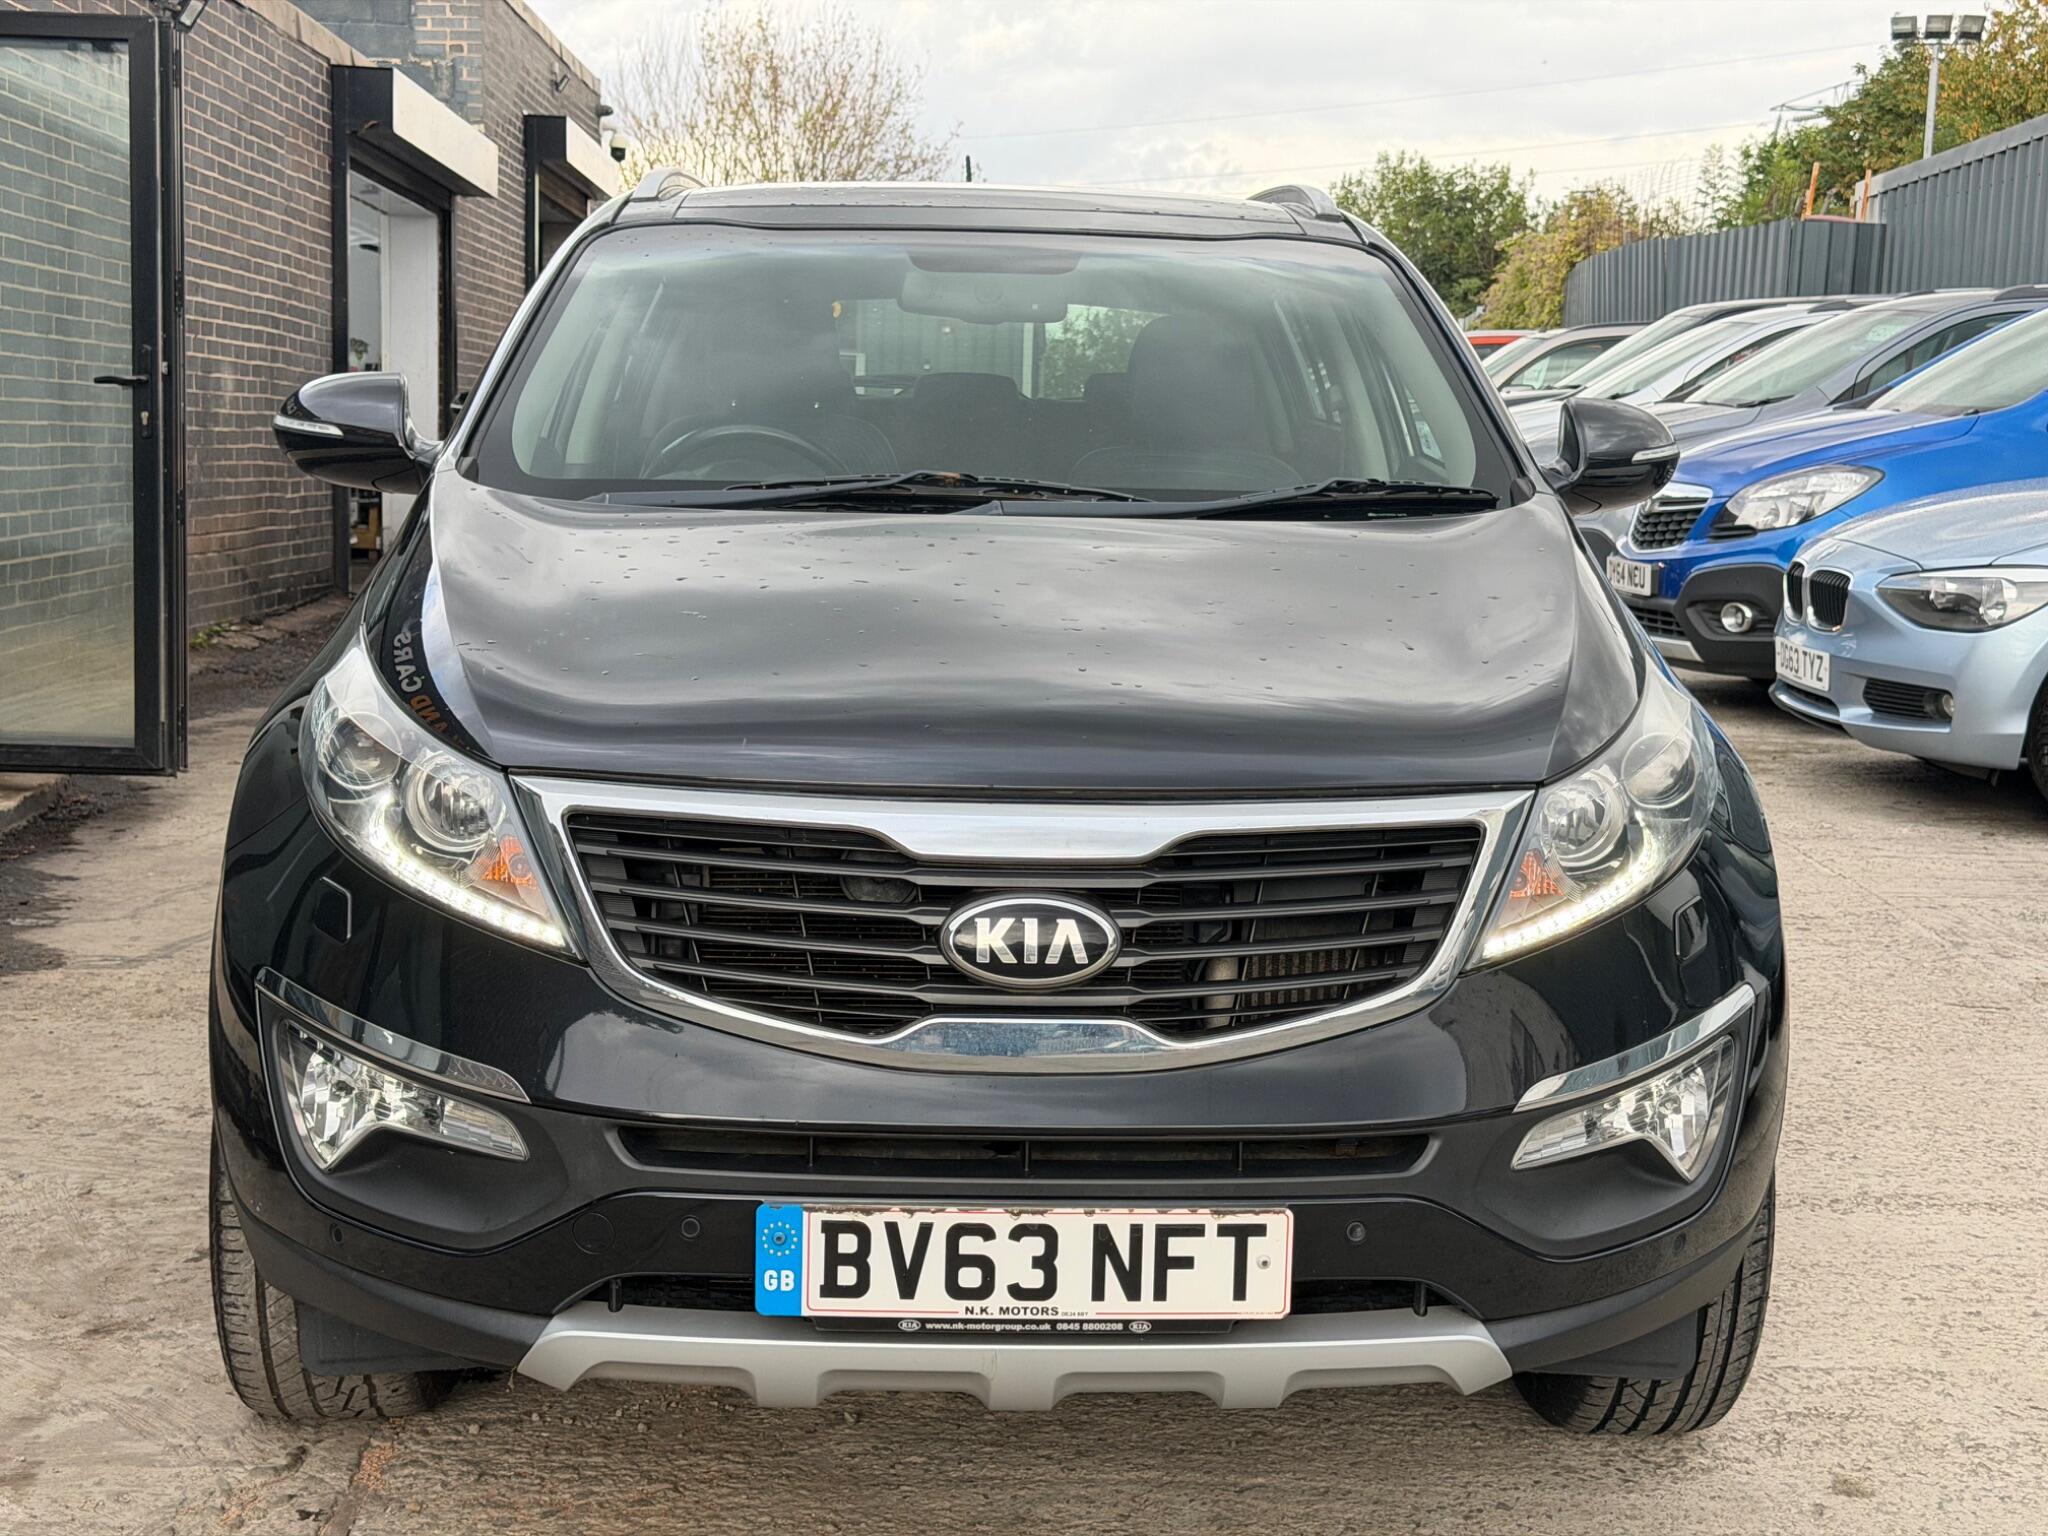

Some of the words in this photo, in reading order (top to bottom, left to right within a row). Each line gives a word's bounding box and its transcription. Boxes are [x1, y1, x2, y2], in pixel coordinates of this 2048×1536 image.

[1627, 561, 1646, 589] NEU
[1801, 650, 1824, 683] TYZ
[974, 917, 1089, 965] KIA
[819, 1220, 1059, 1301] BV63
[1091, 1222, 1268, 1302] NFT
[763, 1269, 795, 1292] GB
[964, 1305, 995, 1316] N.K.
[998, 1305, 1060, 1317] MOTORS
[925, 1321, 1051, 1332] www.nk-motorgroup.co.uk
[1056, 1322, 1081, 1331] 0845
